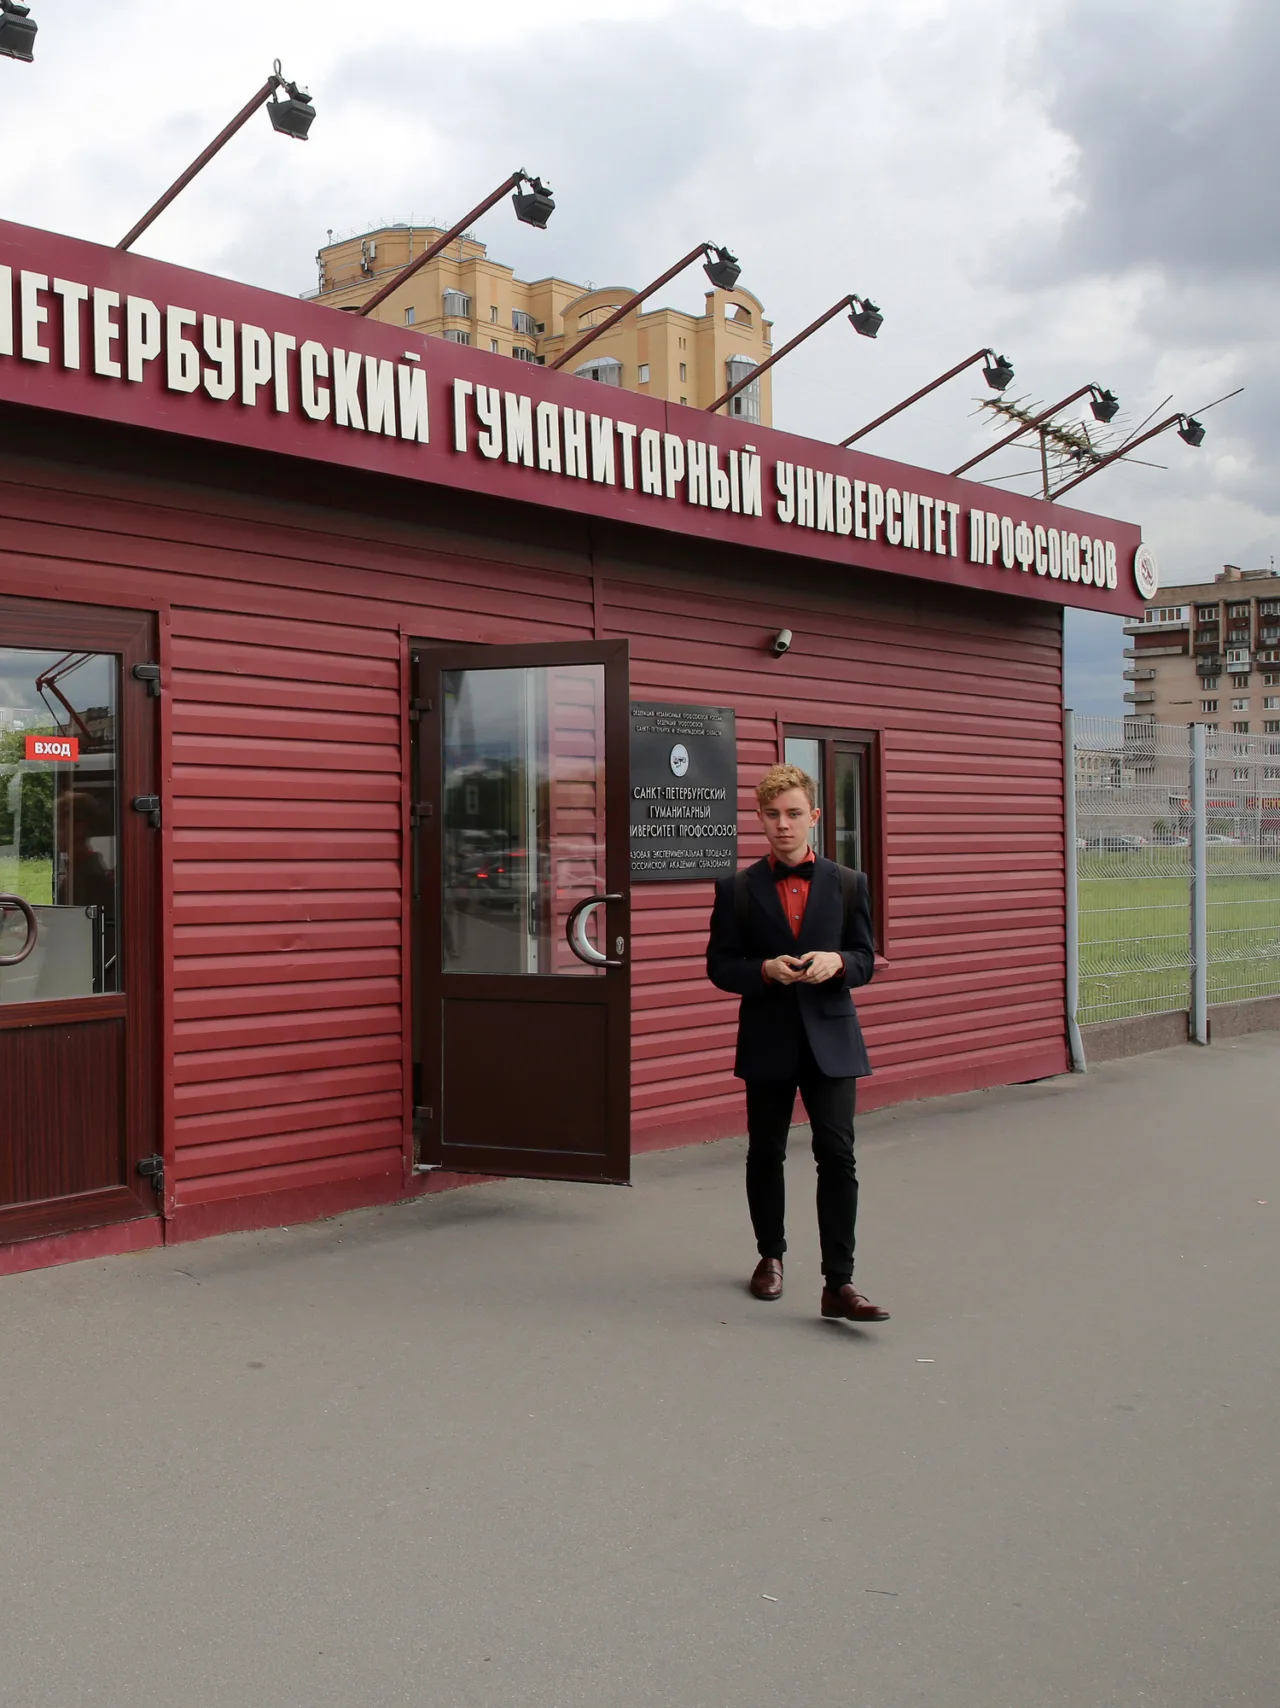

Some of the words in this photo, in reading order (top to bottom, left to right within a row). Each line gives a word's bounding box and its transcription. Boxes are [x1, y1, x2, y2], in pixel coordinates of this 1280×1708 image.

[453, 379, 763, 517] ГУМАНИТАРНЫЙ
[776, 461, 961, 559] УНИВЕРСИТЕТ
[969, 508, 1118, 590] ПРОФСОЮЗОВ
[35, 742, 71, 757] ВХОД
[633, 786, 726, 800] САНКТ-ПЕТЕРБУРГСКИЙ
[650, 805, 711, 818] ГУМАНИТАРНЫЙ
[630, 824, 675, 837] ИВЕРСИТЕТ
[679, 824, 737, 837] ПРОФСОЮЗОВ
[630, 850, 650, 859] АЗОВАЯ
[652, 849, 703, 858] ЭКСПЕРИМЕНТАЛЬНАЯ
[705, 849, 732, 857] ПЛОЩАДКА
[631, 860, 666, 870] ОССИЙСКОЙ
[669, 860, 696, 869] АКАДЕМИИ
[698, 859, 731, 868] ОБРАЗОВАНИЯ
